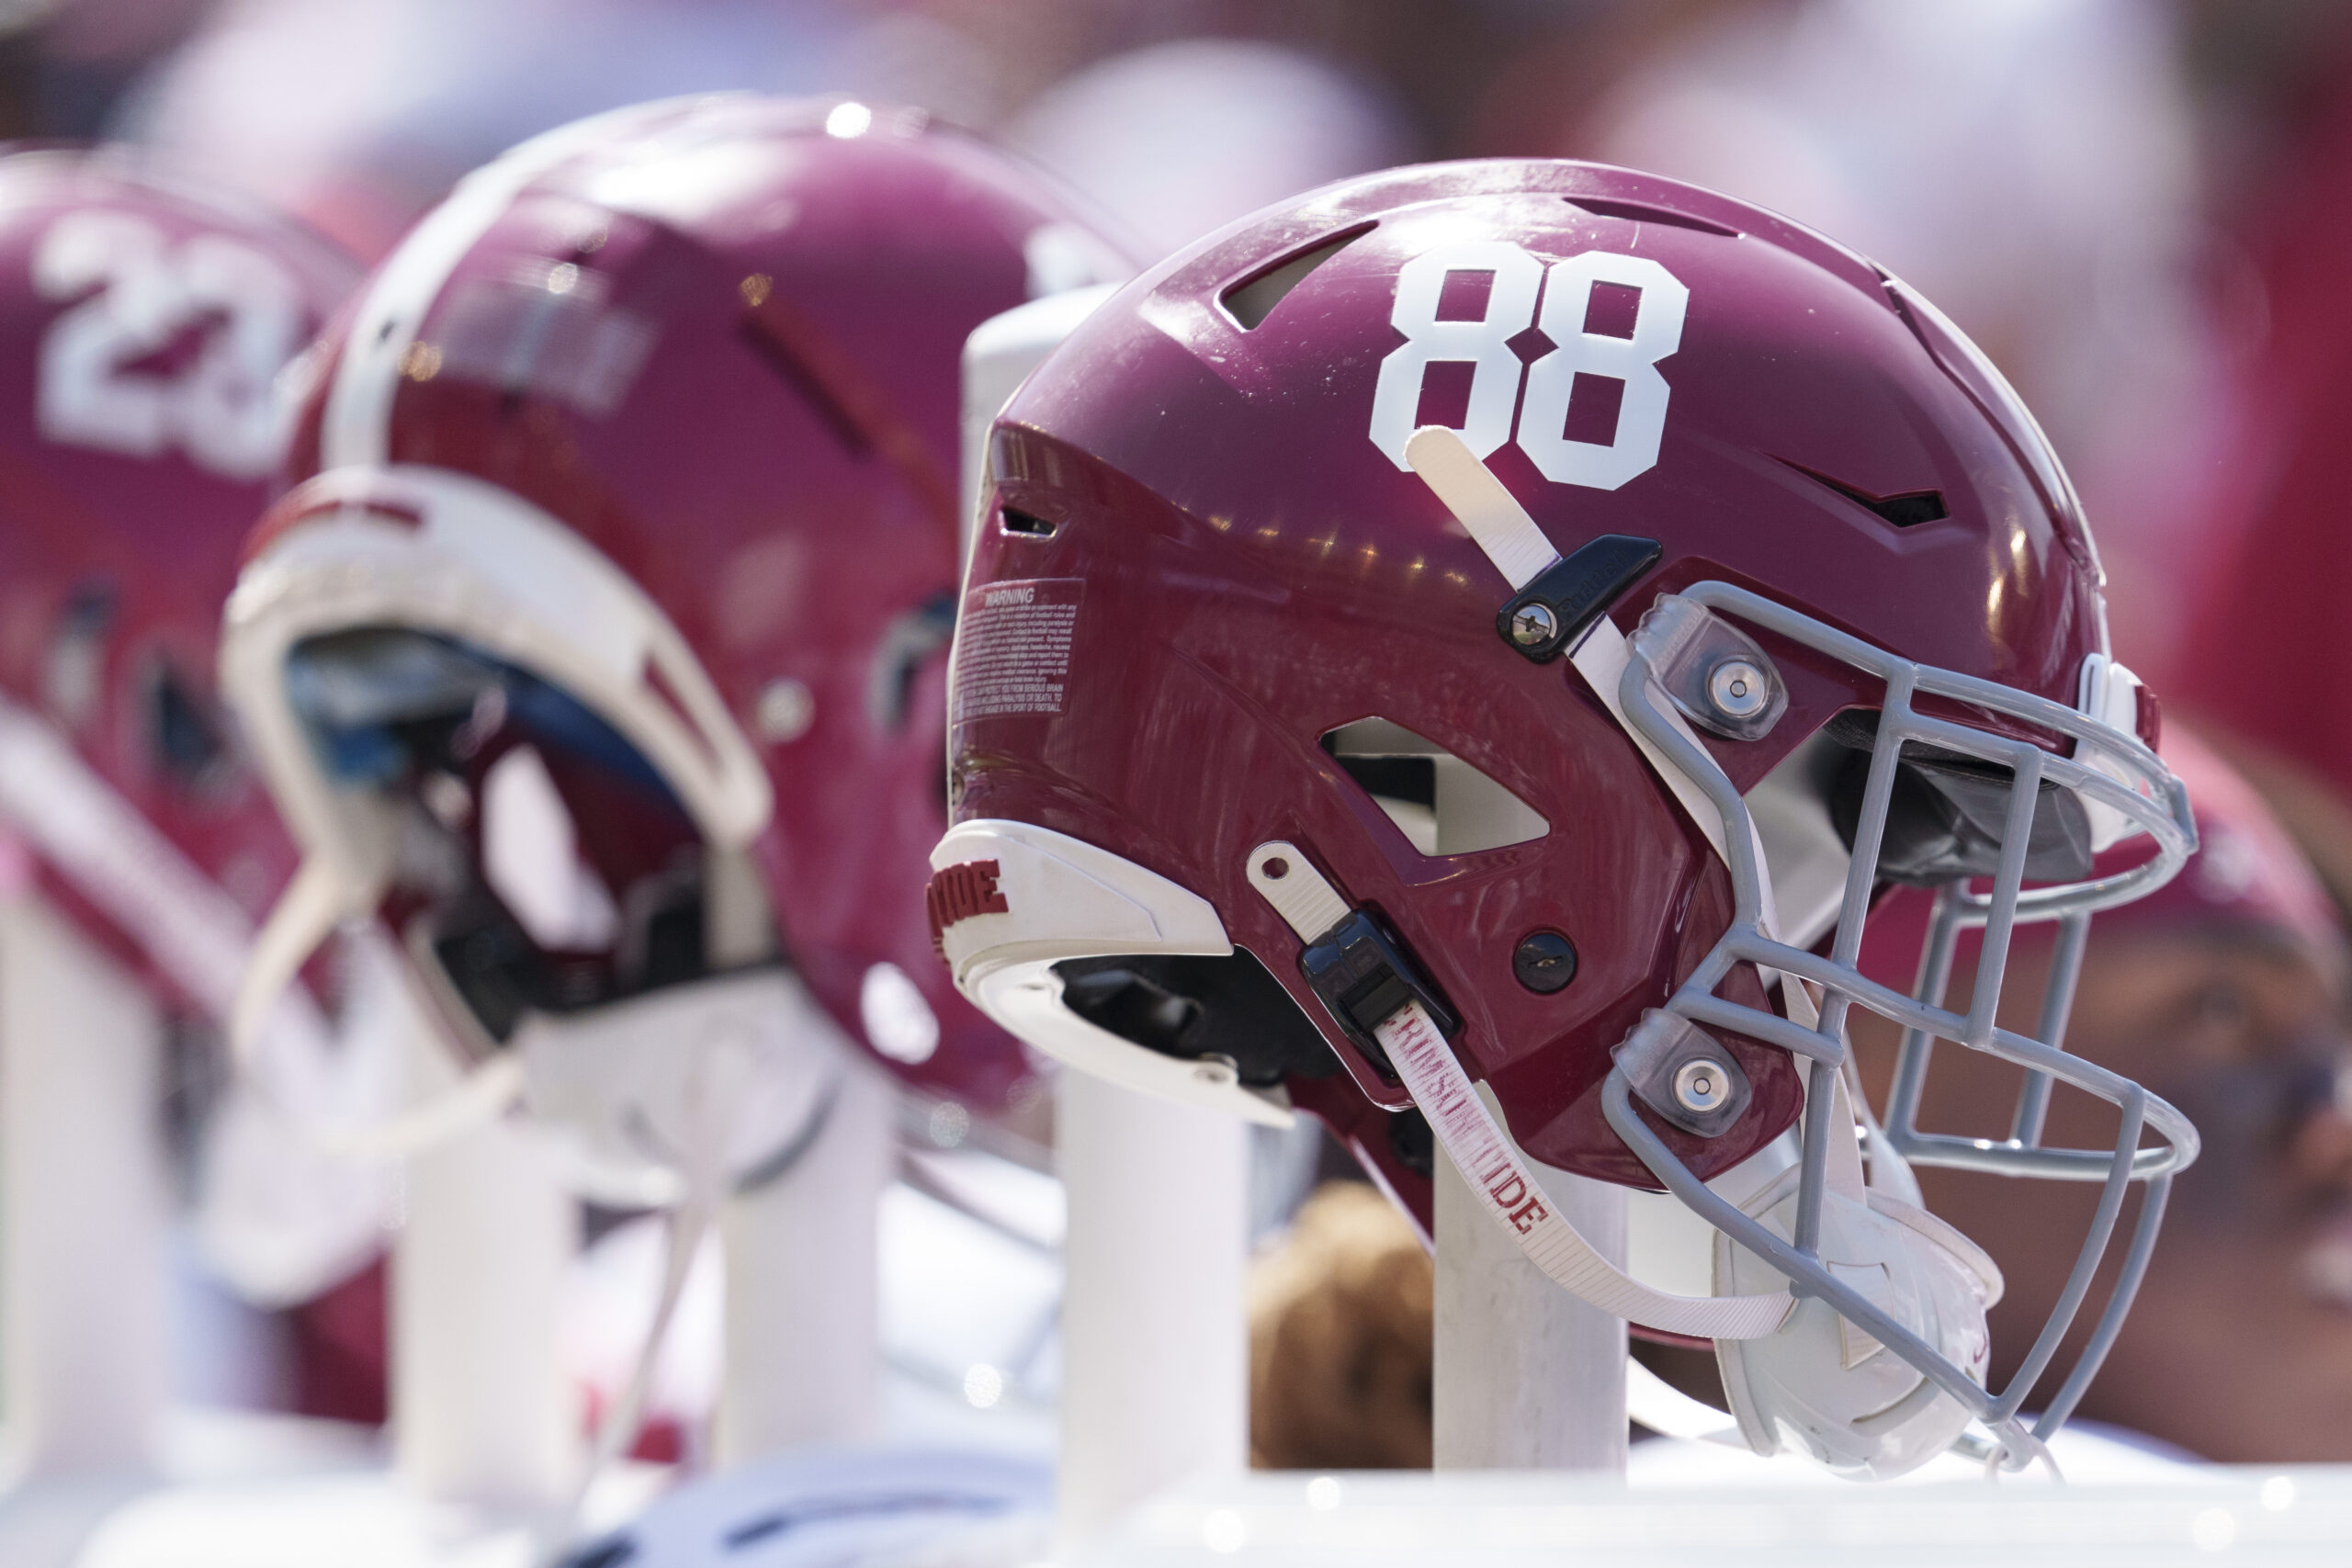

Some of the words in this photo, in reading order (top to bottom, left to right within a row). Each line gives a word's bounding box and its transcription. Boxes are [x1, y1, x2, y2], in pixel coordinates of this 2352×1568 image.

[1369, 242, 1690, 491] 88
[985, 587, 1035, 606] WARNING
[1555, 547, 1634, 623] Riddell
